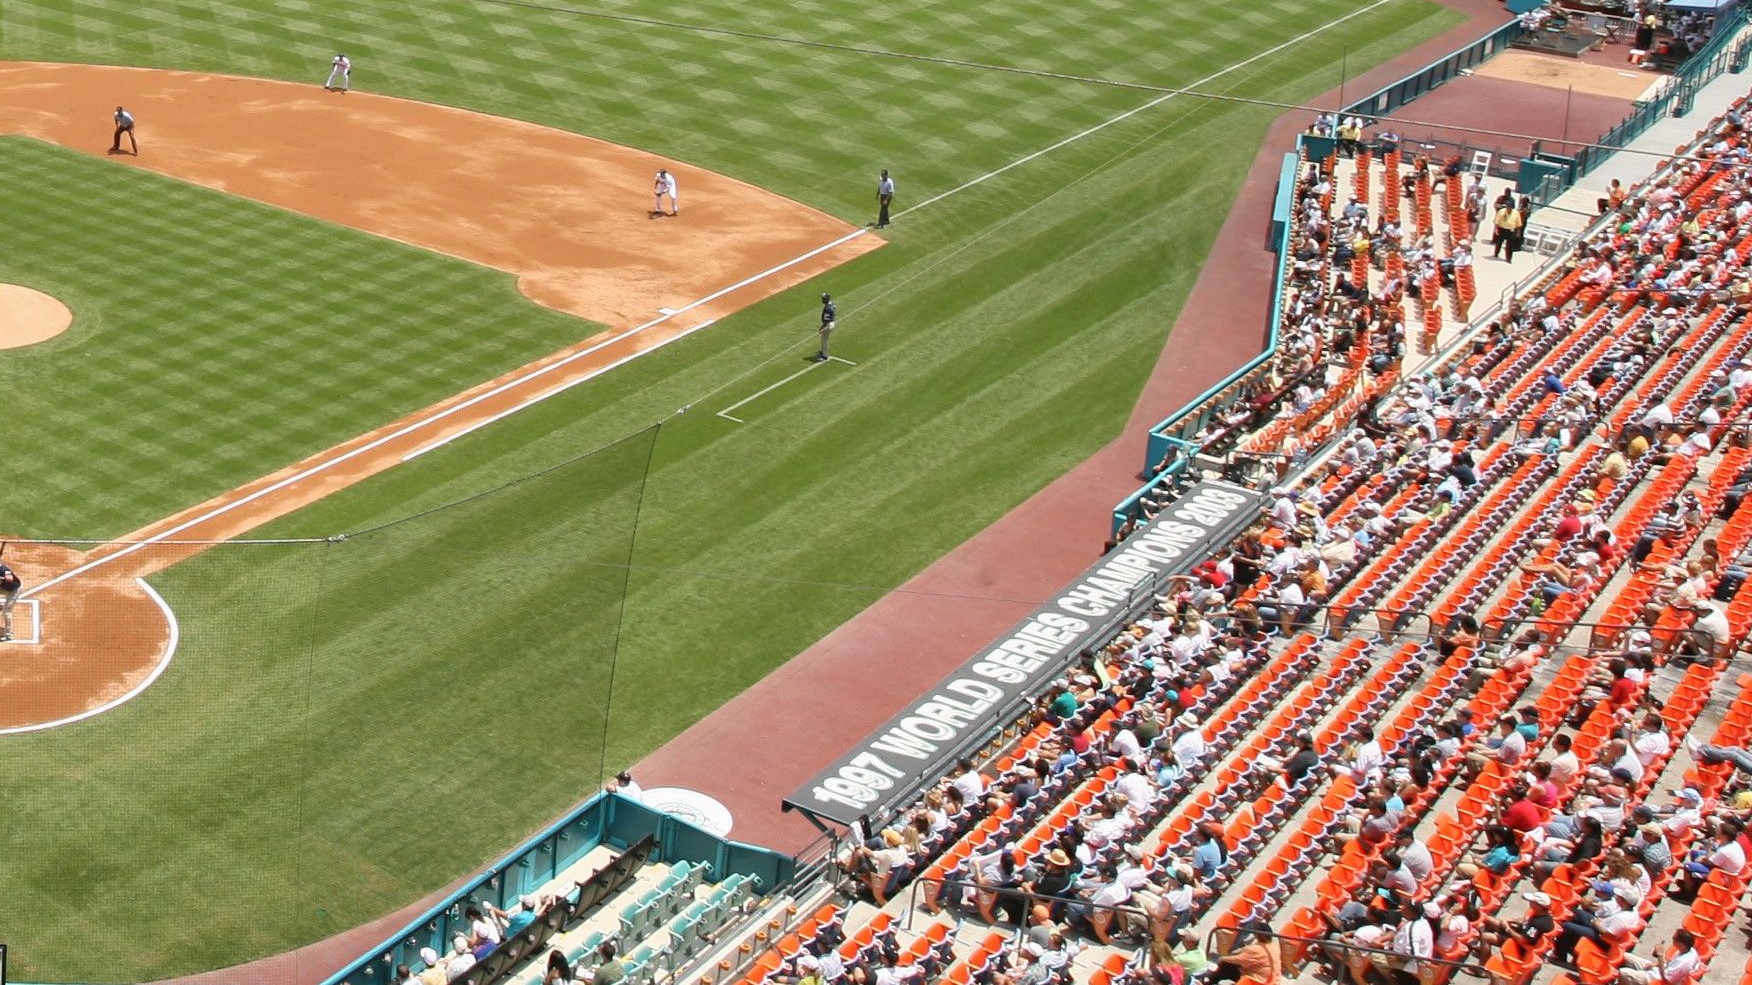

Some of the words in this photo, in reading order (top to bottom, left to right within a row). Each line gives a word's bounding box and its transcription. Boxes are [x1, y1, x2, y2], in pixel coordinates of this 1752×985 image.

[812, 752, 907, 810] 1997
[872, 676, 1005, 760] WORLD
[972, 612, 1091, 684] SERIES
[1057, 520, 1207, 617] CHAMPIONS
[1175, 488, 1248, 527] 2003
